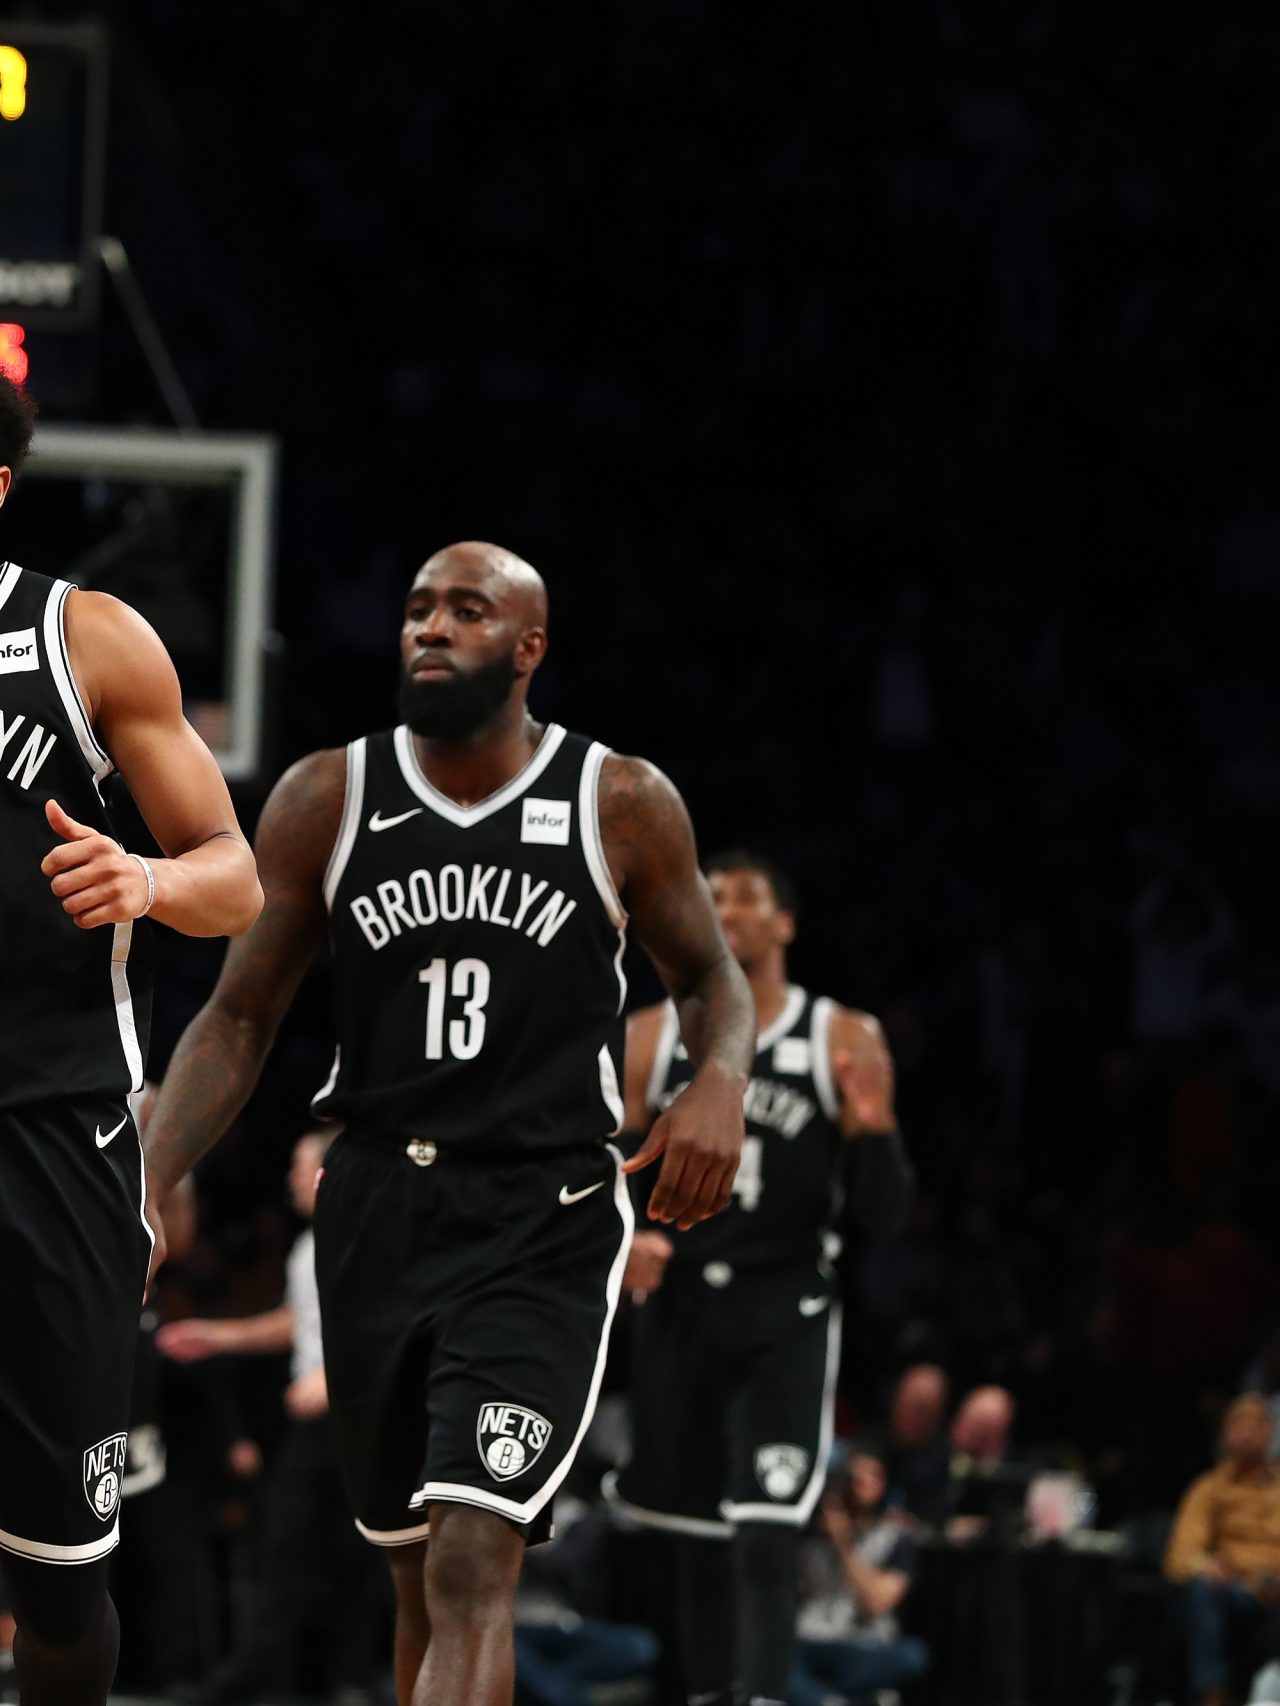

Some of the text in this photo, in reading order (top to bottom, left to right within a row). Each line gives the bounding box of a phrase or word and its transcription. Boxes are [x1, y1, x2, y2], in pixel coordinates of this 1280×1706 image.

[526, 812, 567, 828] infor
[349, 862, 578, 951] BROOKLYN
[418, 957, 492, 1061] 13
[480, 1406, 548, 1451] NETS
[86, 1435, 127, 1483] NETS
